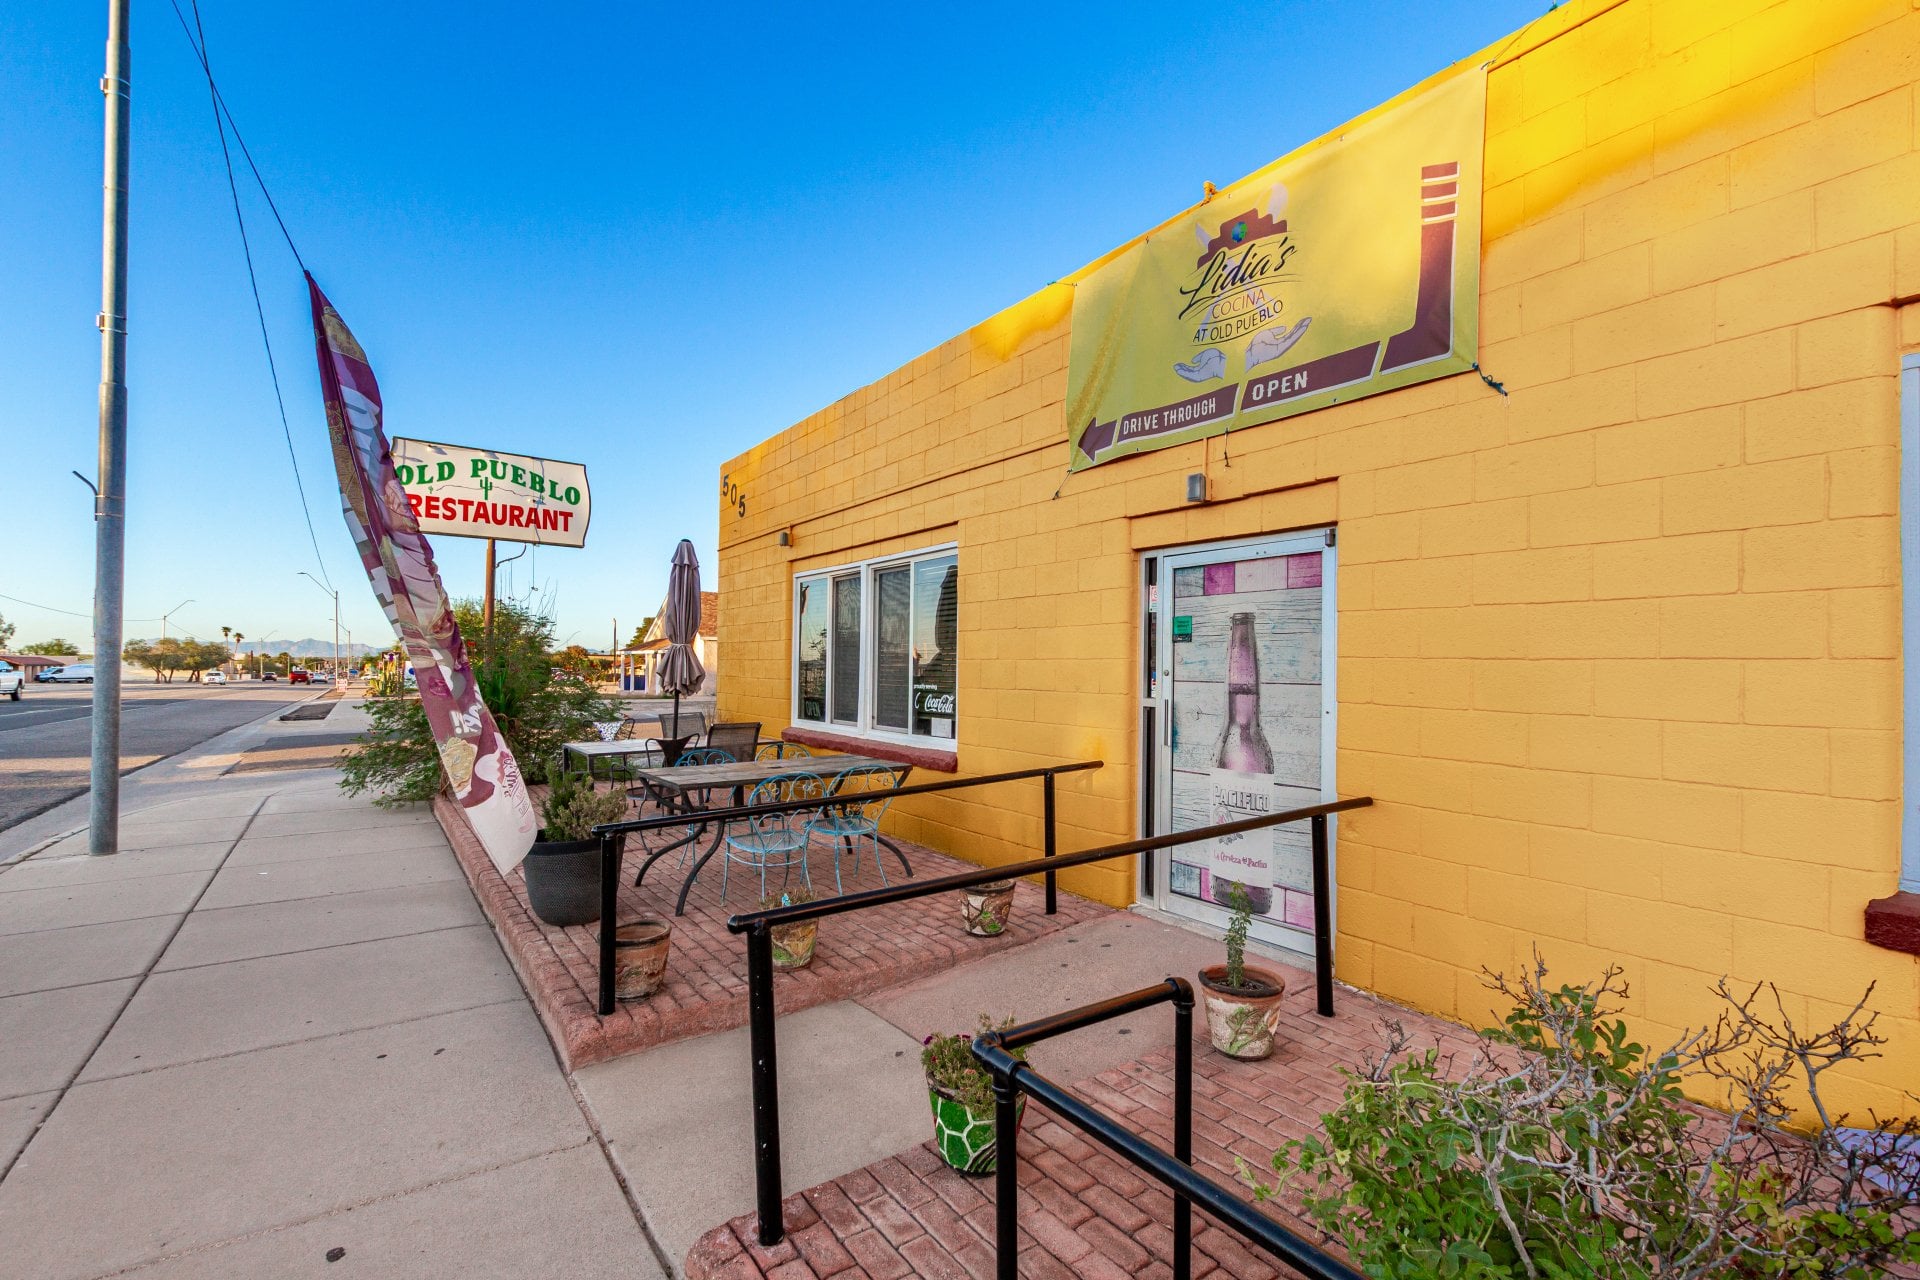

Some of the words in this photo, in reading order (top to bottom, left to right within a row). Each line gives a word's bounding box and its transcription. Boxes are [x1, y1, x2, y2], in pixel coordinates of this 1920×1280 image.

[1179, 236, 1297, 319] Lidia's
[1193, 328, 1208, 342] AT
[1210, 323, 1232, 340] OLD
[1237, 300, 1283, 334] PUEBLO
[1212, 289, 1265, 319] COCINA
[1123, 414, 1158, 434] DRIVE
[1163, 397, 1216, 426] THROUGH
[1252, 370, 1308, 401] OPEN
[395, 461, 455, 486] OLD
[470, 458, 581, 506] PUEBLO
[722, 474, 746, 518] 505
[405, 494, 573, 532] RESTAURANT
